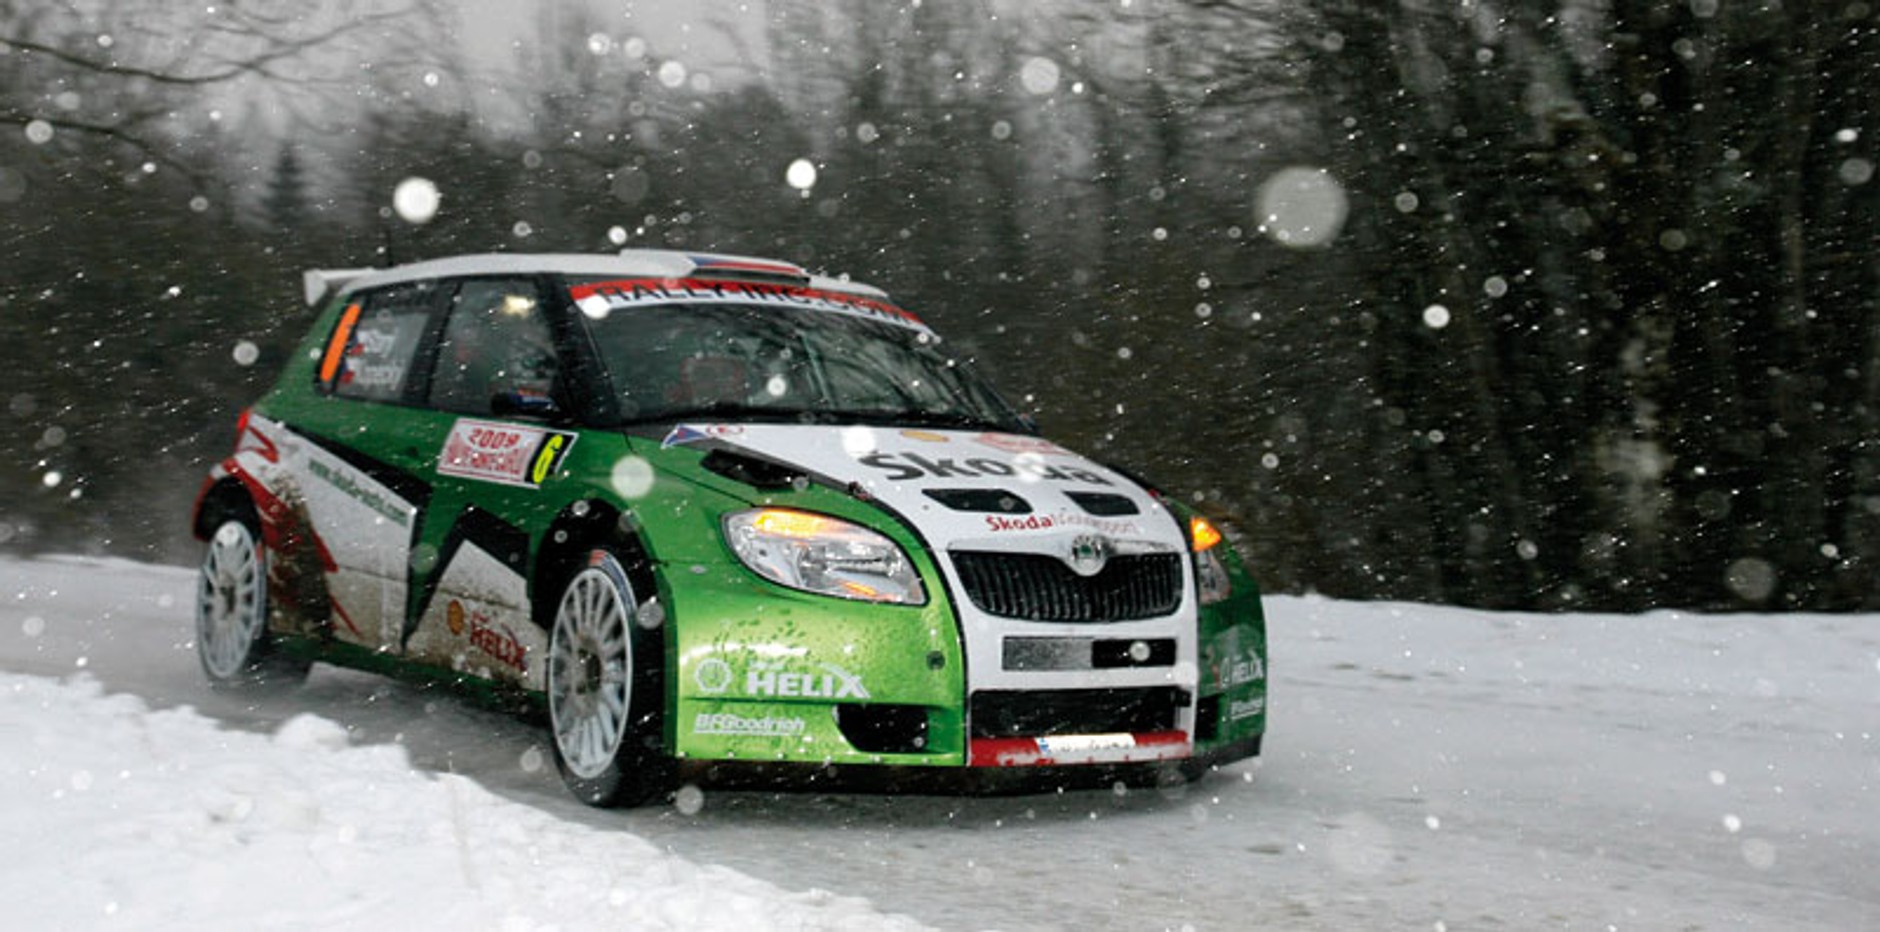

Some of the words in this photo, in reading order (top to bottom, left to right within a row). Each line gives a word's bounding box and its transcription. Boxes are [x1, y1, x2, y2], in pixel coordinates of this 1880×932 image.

[469, 427, 521, 450] 2009
[532, 433, 563, 484] 6
[746, 663, 872, 699] HELIX
